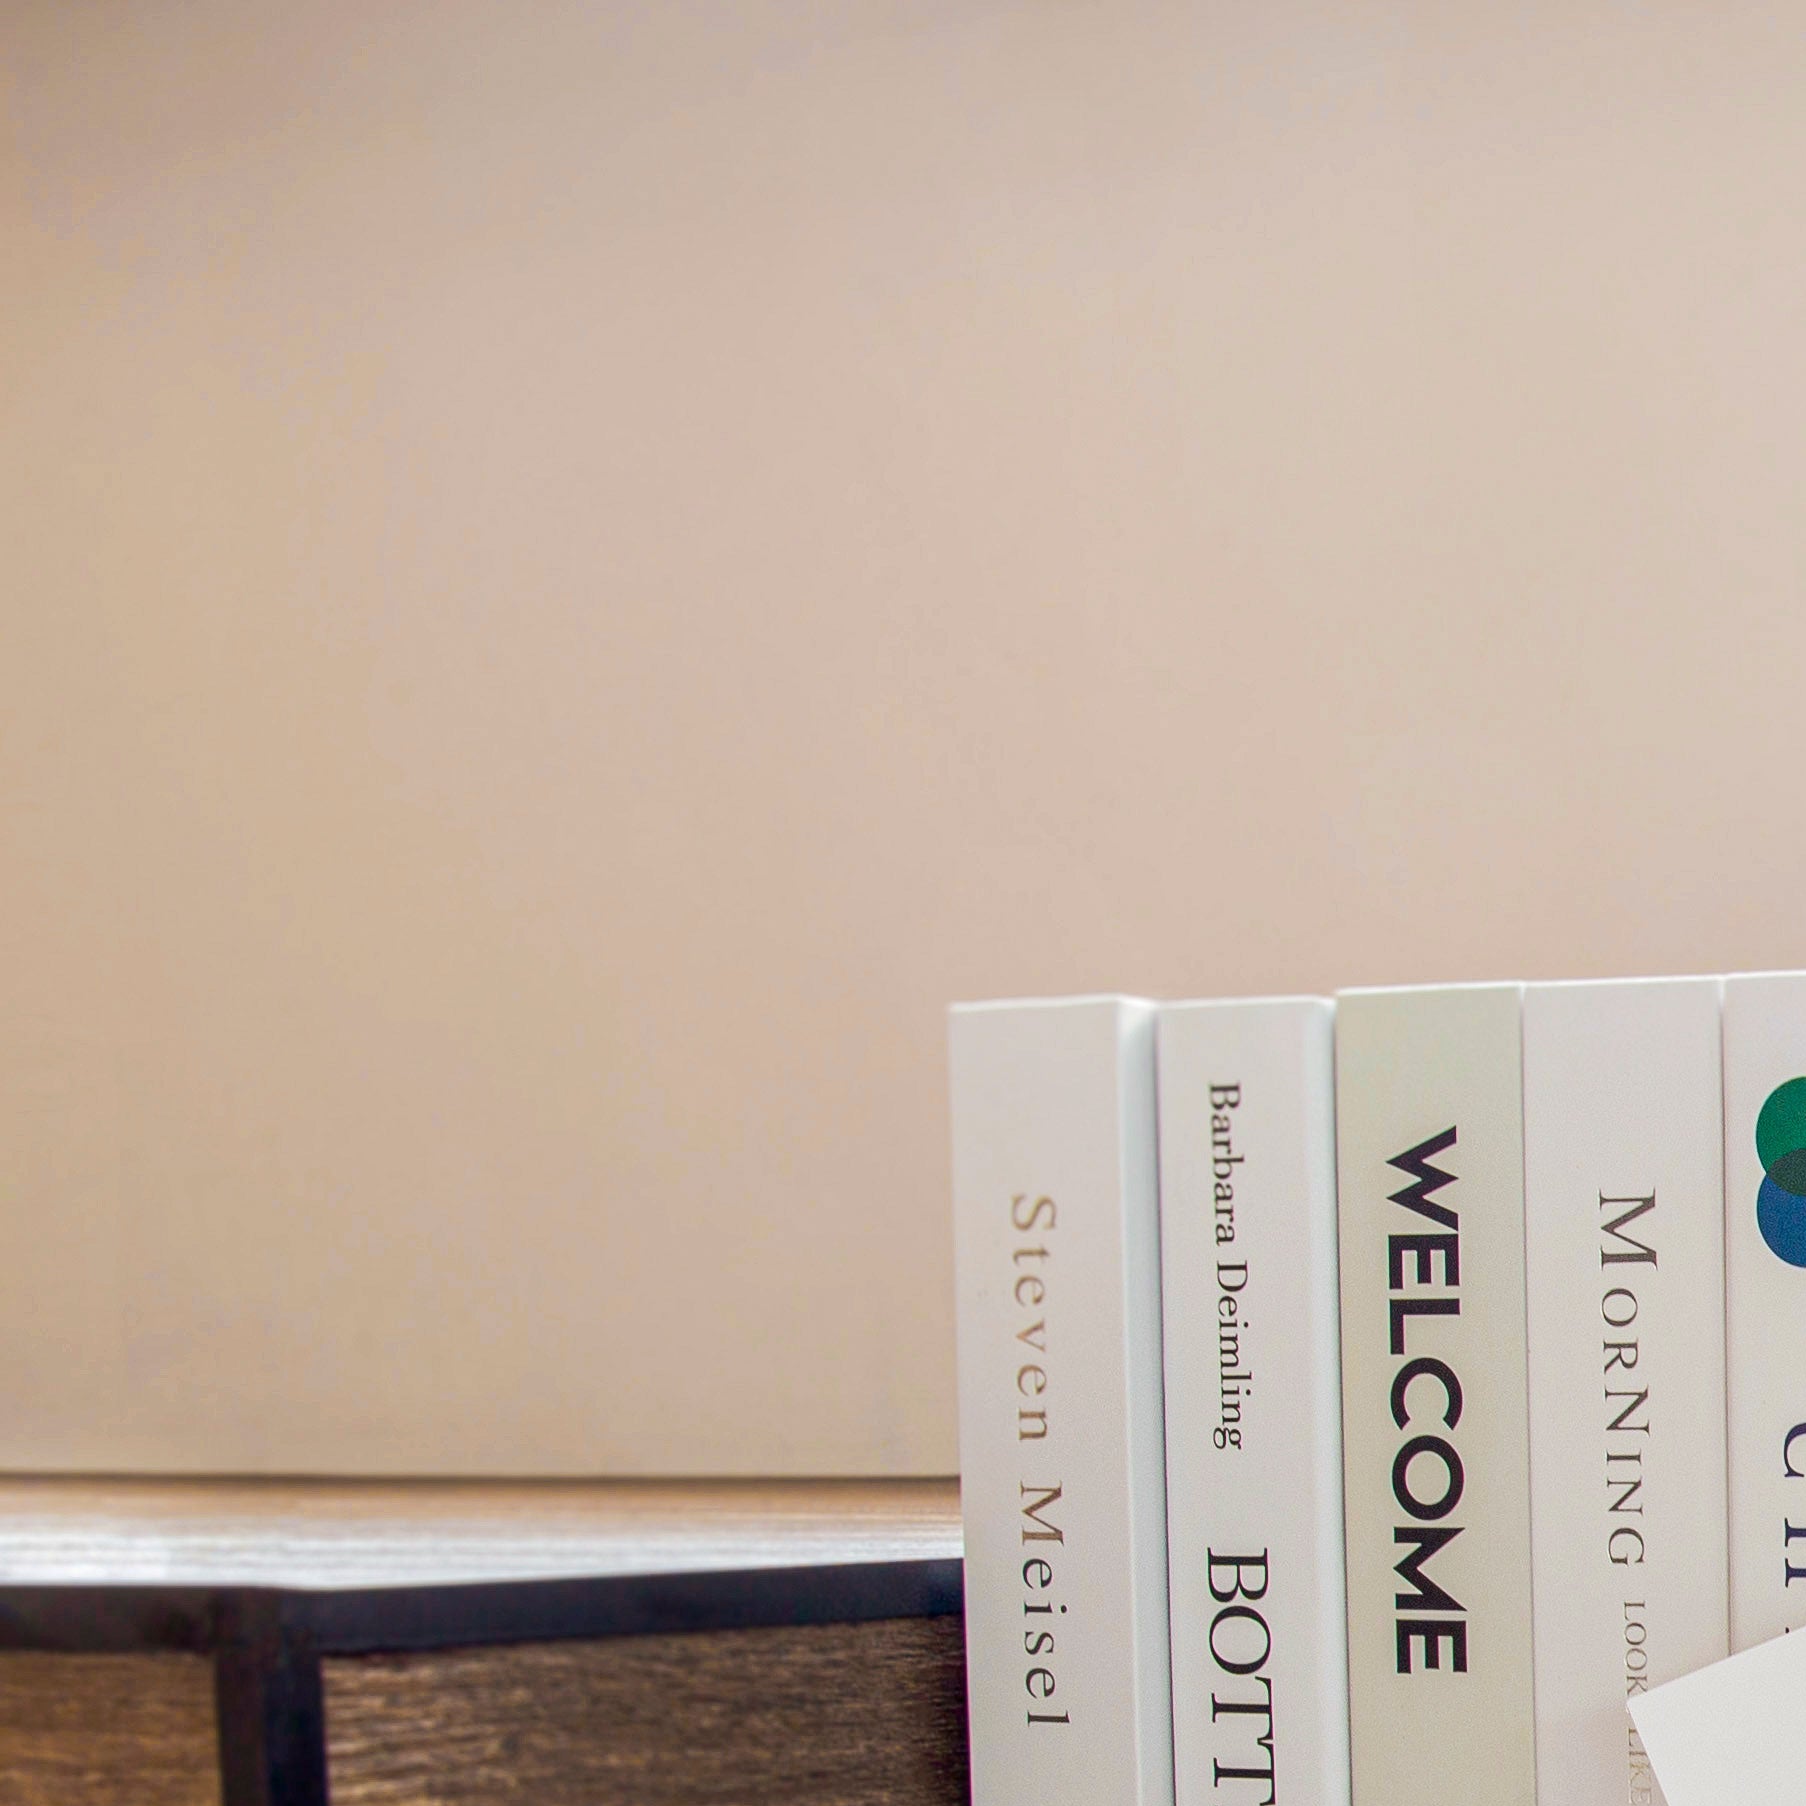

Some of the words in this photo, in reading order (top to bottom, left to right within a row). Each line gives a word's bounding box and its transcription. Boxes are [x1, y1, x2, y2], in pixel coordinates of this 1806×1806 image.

[1209, 1081, 1245, 1247] Barbara
[1012, 1193, 1056, 1443] Steven
[1213, 1261, 1253, 1451] Deimling
[1386, 1124, 1468, 1676] WELCOME
[1598, 1189, 1658, 1566] MORNING
[1021, 1481, 1070, 1726] Meisel
[1623, 1601, 1649, 1712] LOOK
